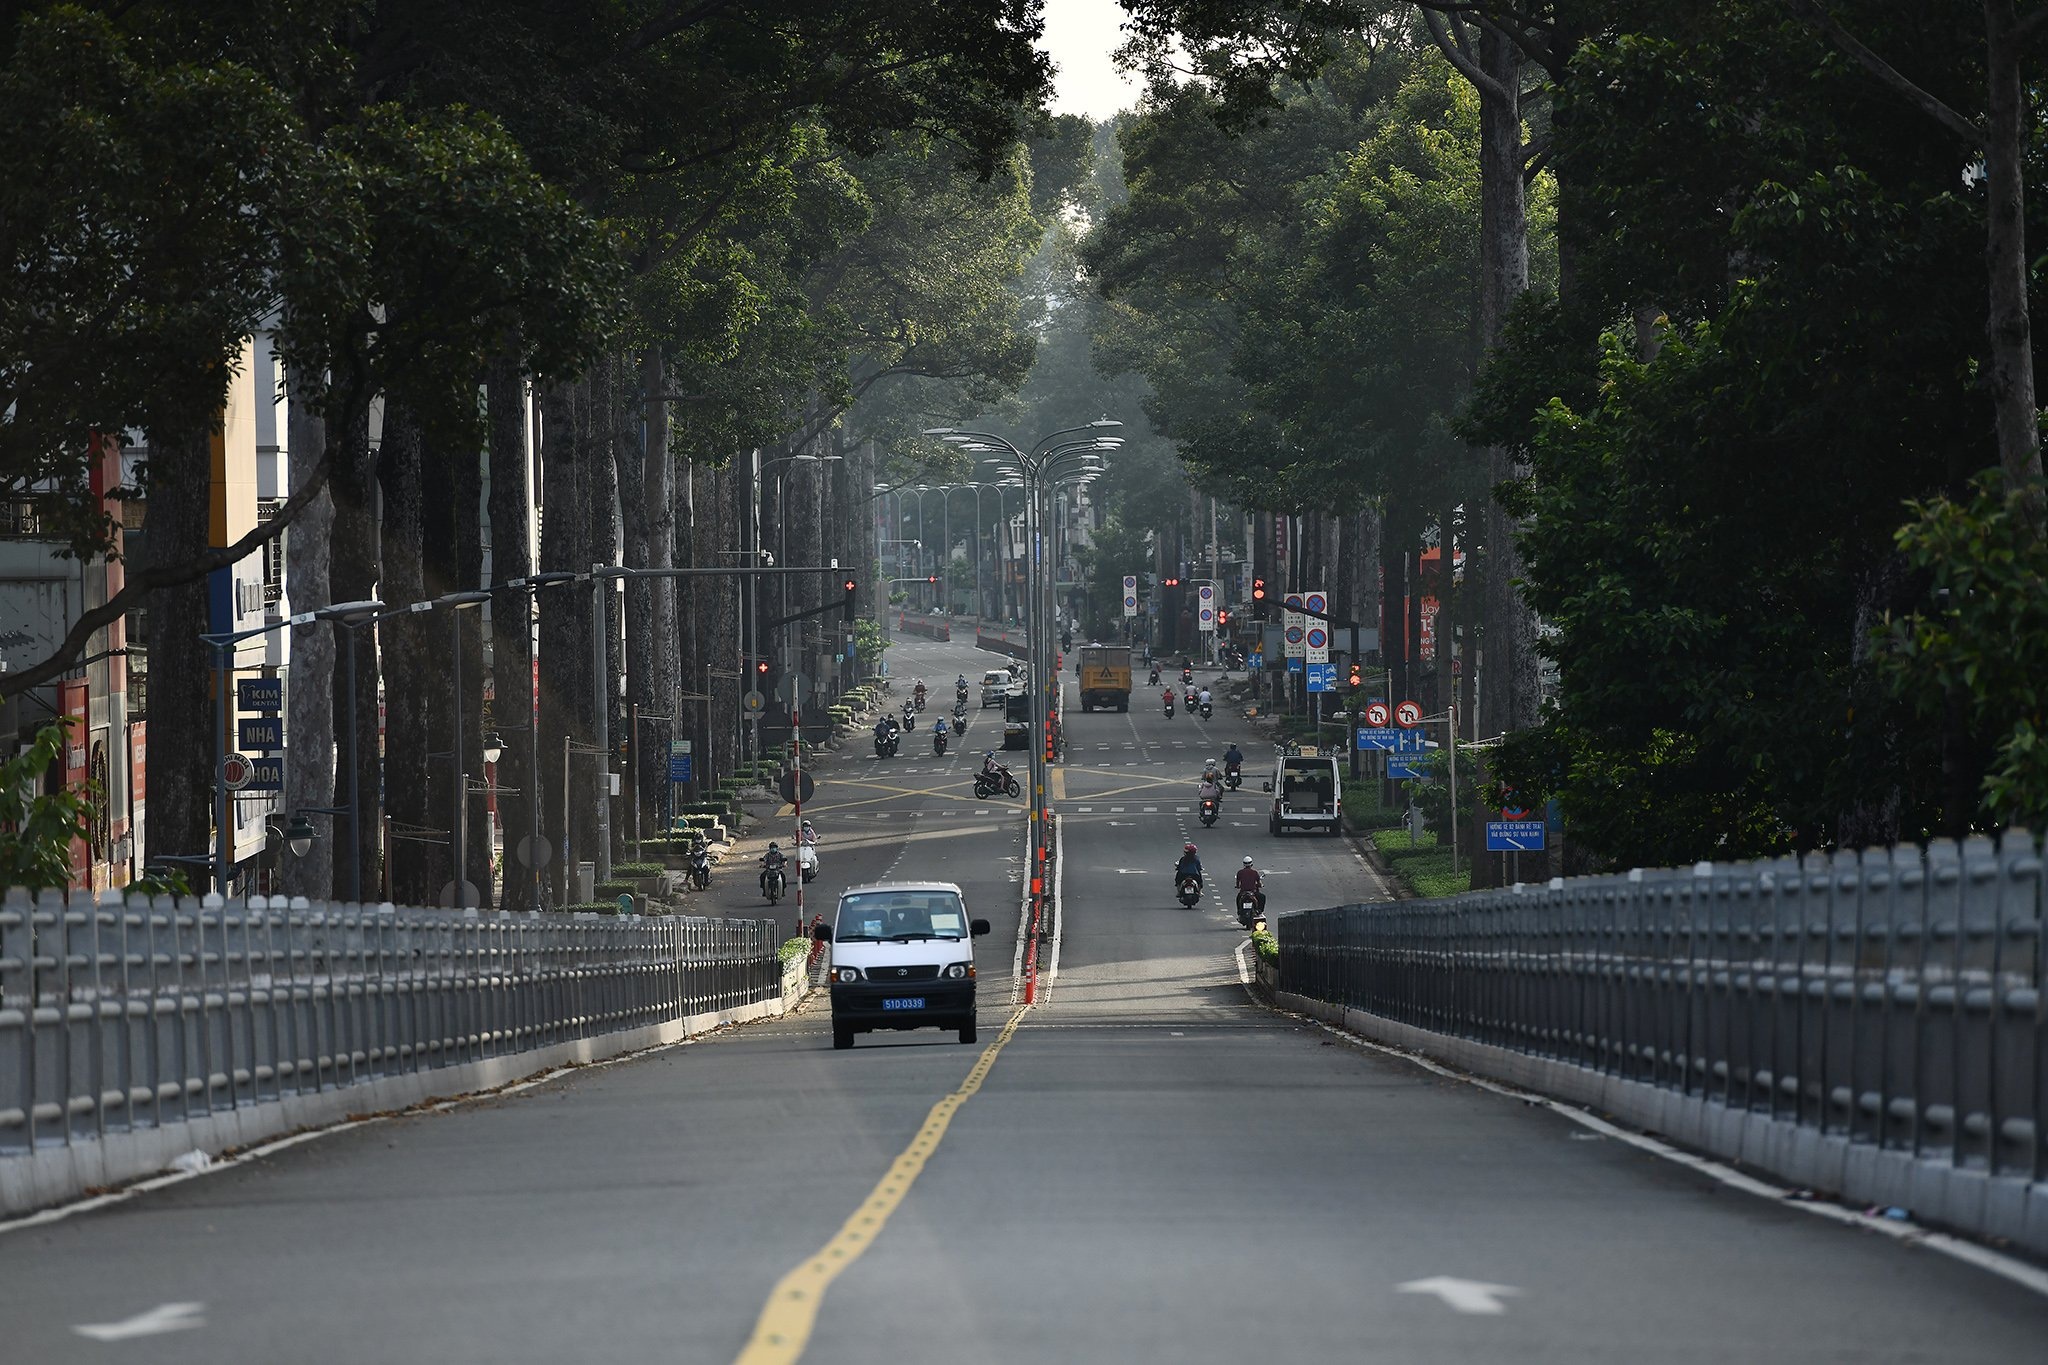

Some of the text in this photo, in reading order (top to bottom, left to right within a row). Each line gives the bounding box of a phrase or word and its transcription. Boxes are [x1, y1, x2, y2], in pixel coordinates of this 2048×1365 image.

[252, 689, 278, 699] KIM
[246, 726, 275, 743] NHA
[252, 766, 280, 783] HOA
